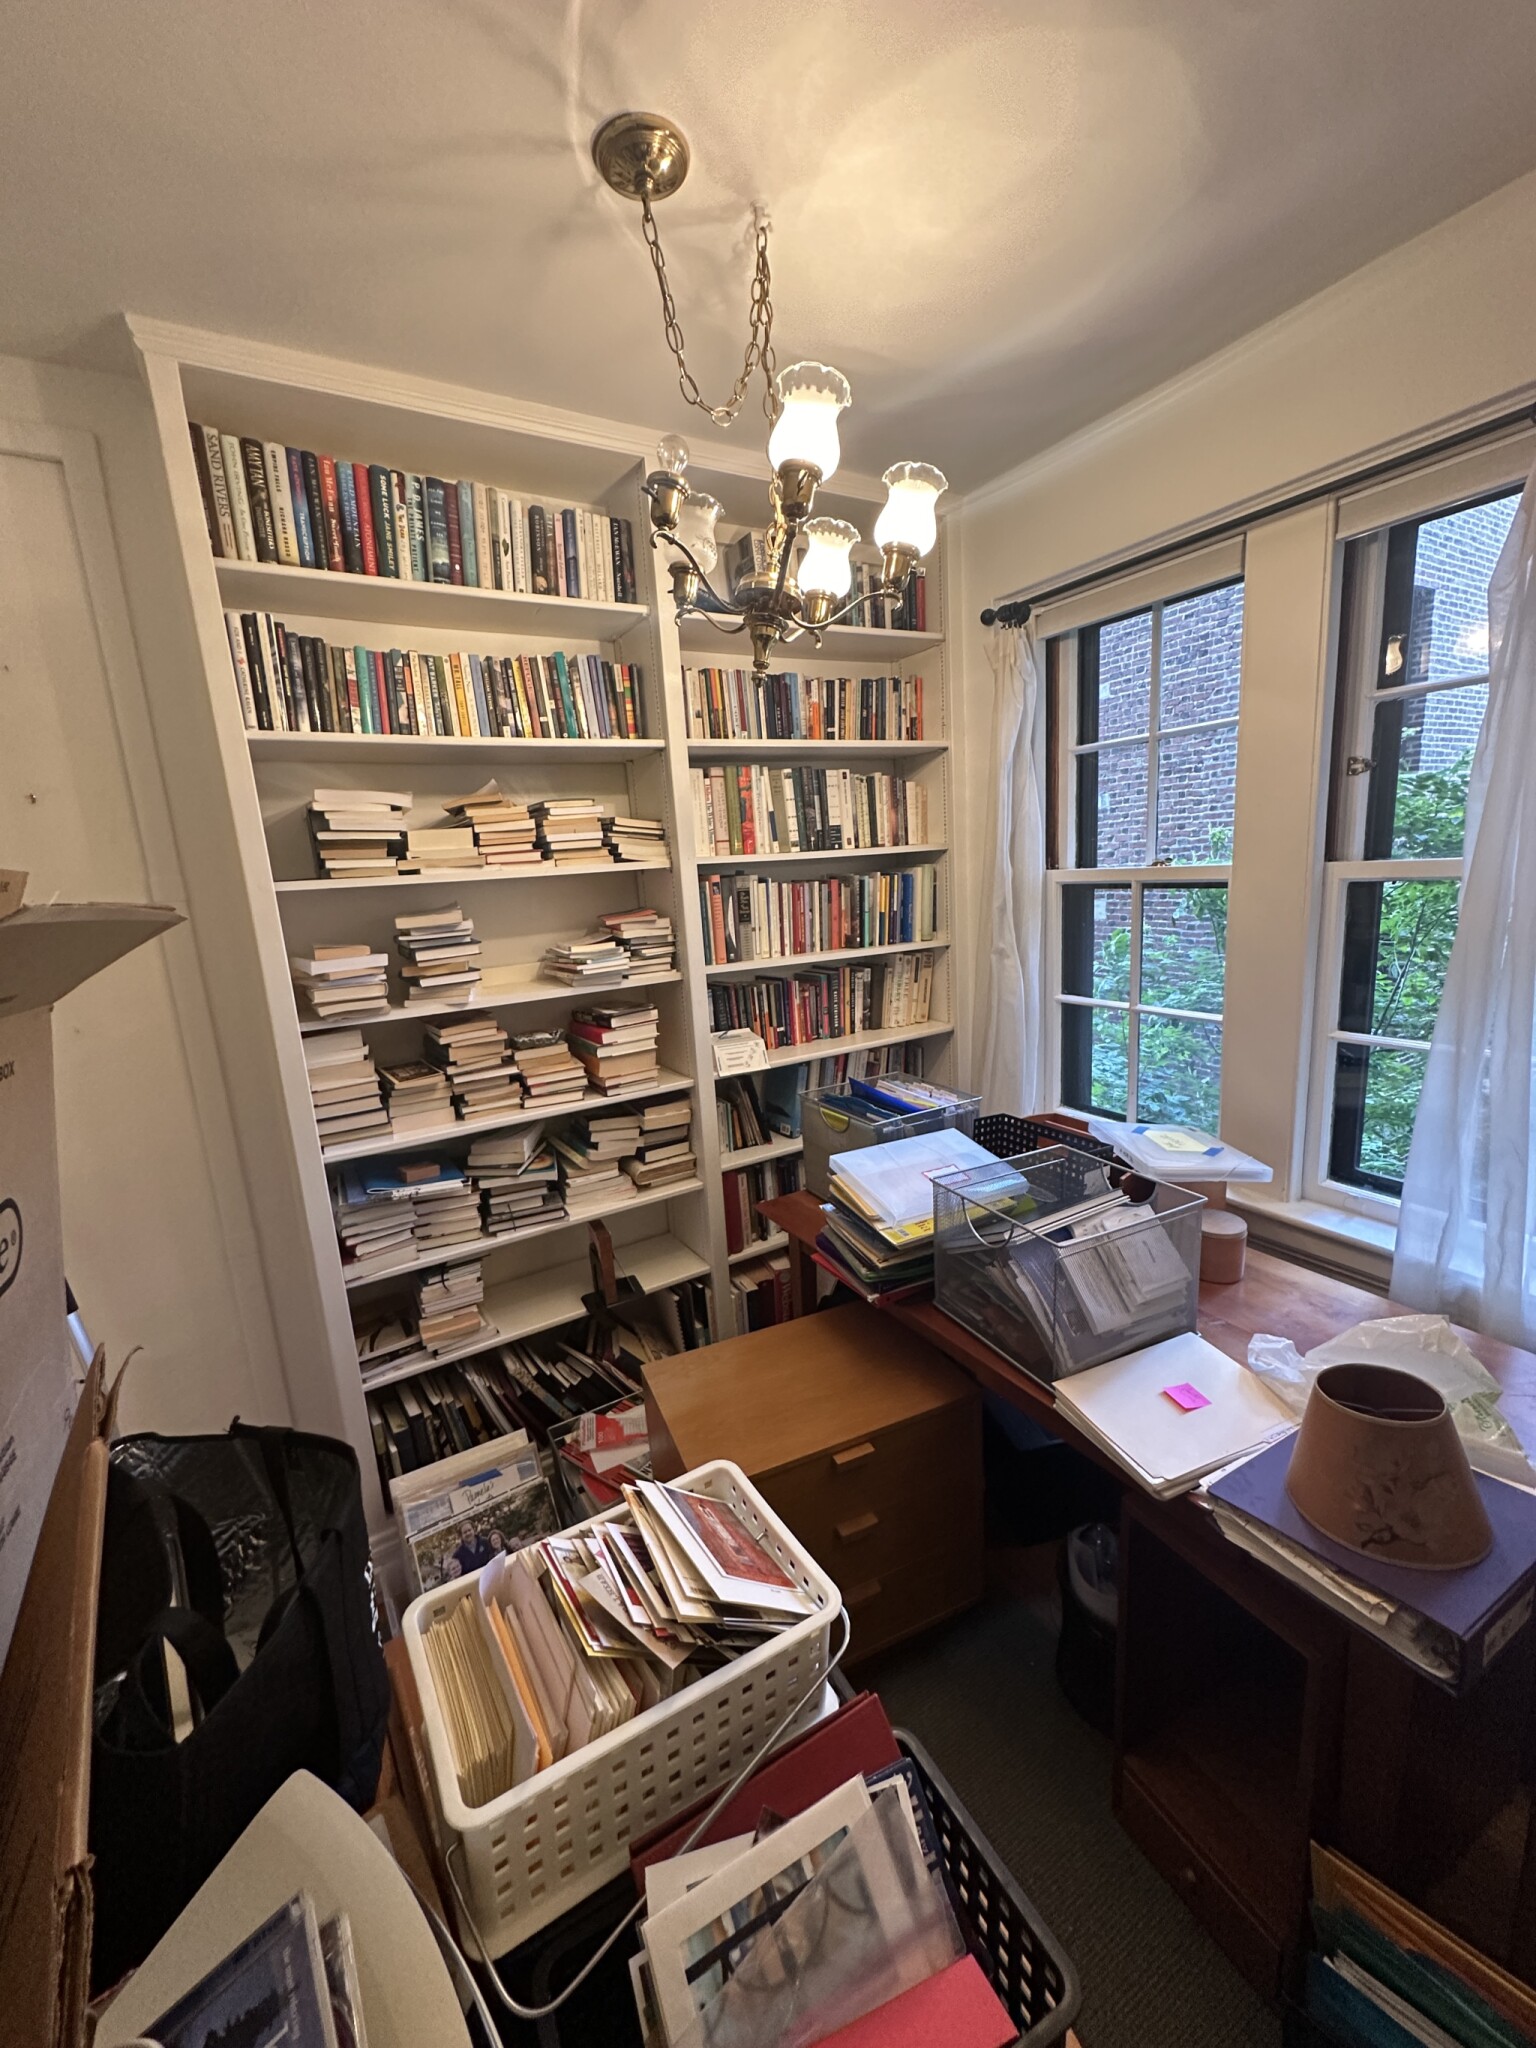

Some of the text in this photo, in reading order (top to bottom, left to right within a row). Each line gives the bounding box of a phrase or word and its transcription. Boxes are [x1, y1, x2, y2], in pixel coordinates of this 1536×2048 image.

[206, 433, 222, 470] SAND
[244, 442, 266, 489] AMY TAN
[269, 450, 279, 474] EMPIRE
[307, 457, 316, 474] IAN
[322, 459, 332, 475] Ian
[227, 442, 245, 505] JOHN IRVING
[213, 473, 230, 518] RIVERS
[345, 469, 362, 549] COLD MOUNTAIN
[411, 480, 425, 542] P. D. JAMES
[278, 506, 289, 535] RICHARD
[298, 512, 312, 561] TRANSCRIPTION
[379, 474, 396, 571] SOME LUCK JANE SMILEY
[546, 513, 554, 537] LILA
[363, 522, 377, 573] ATONEMENT
[411, 544, 419, 572] PATIENT
[430, 671, 439, 698] BARKER
